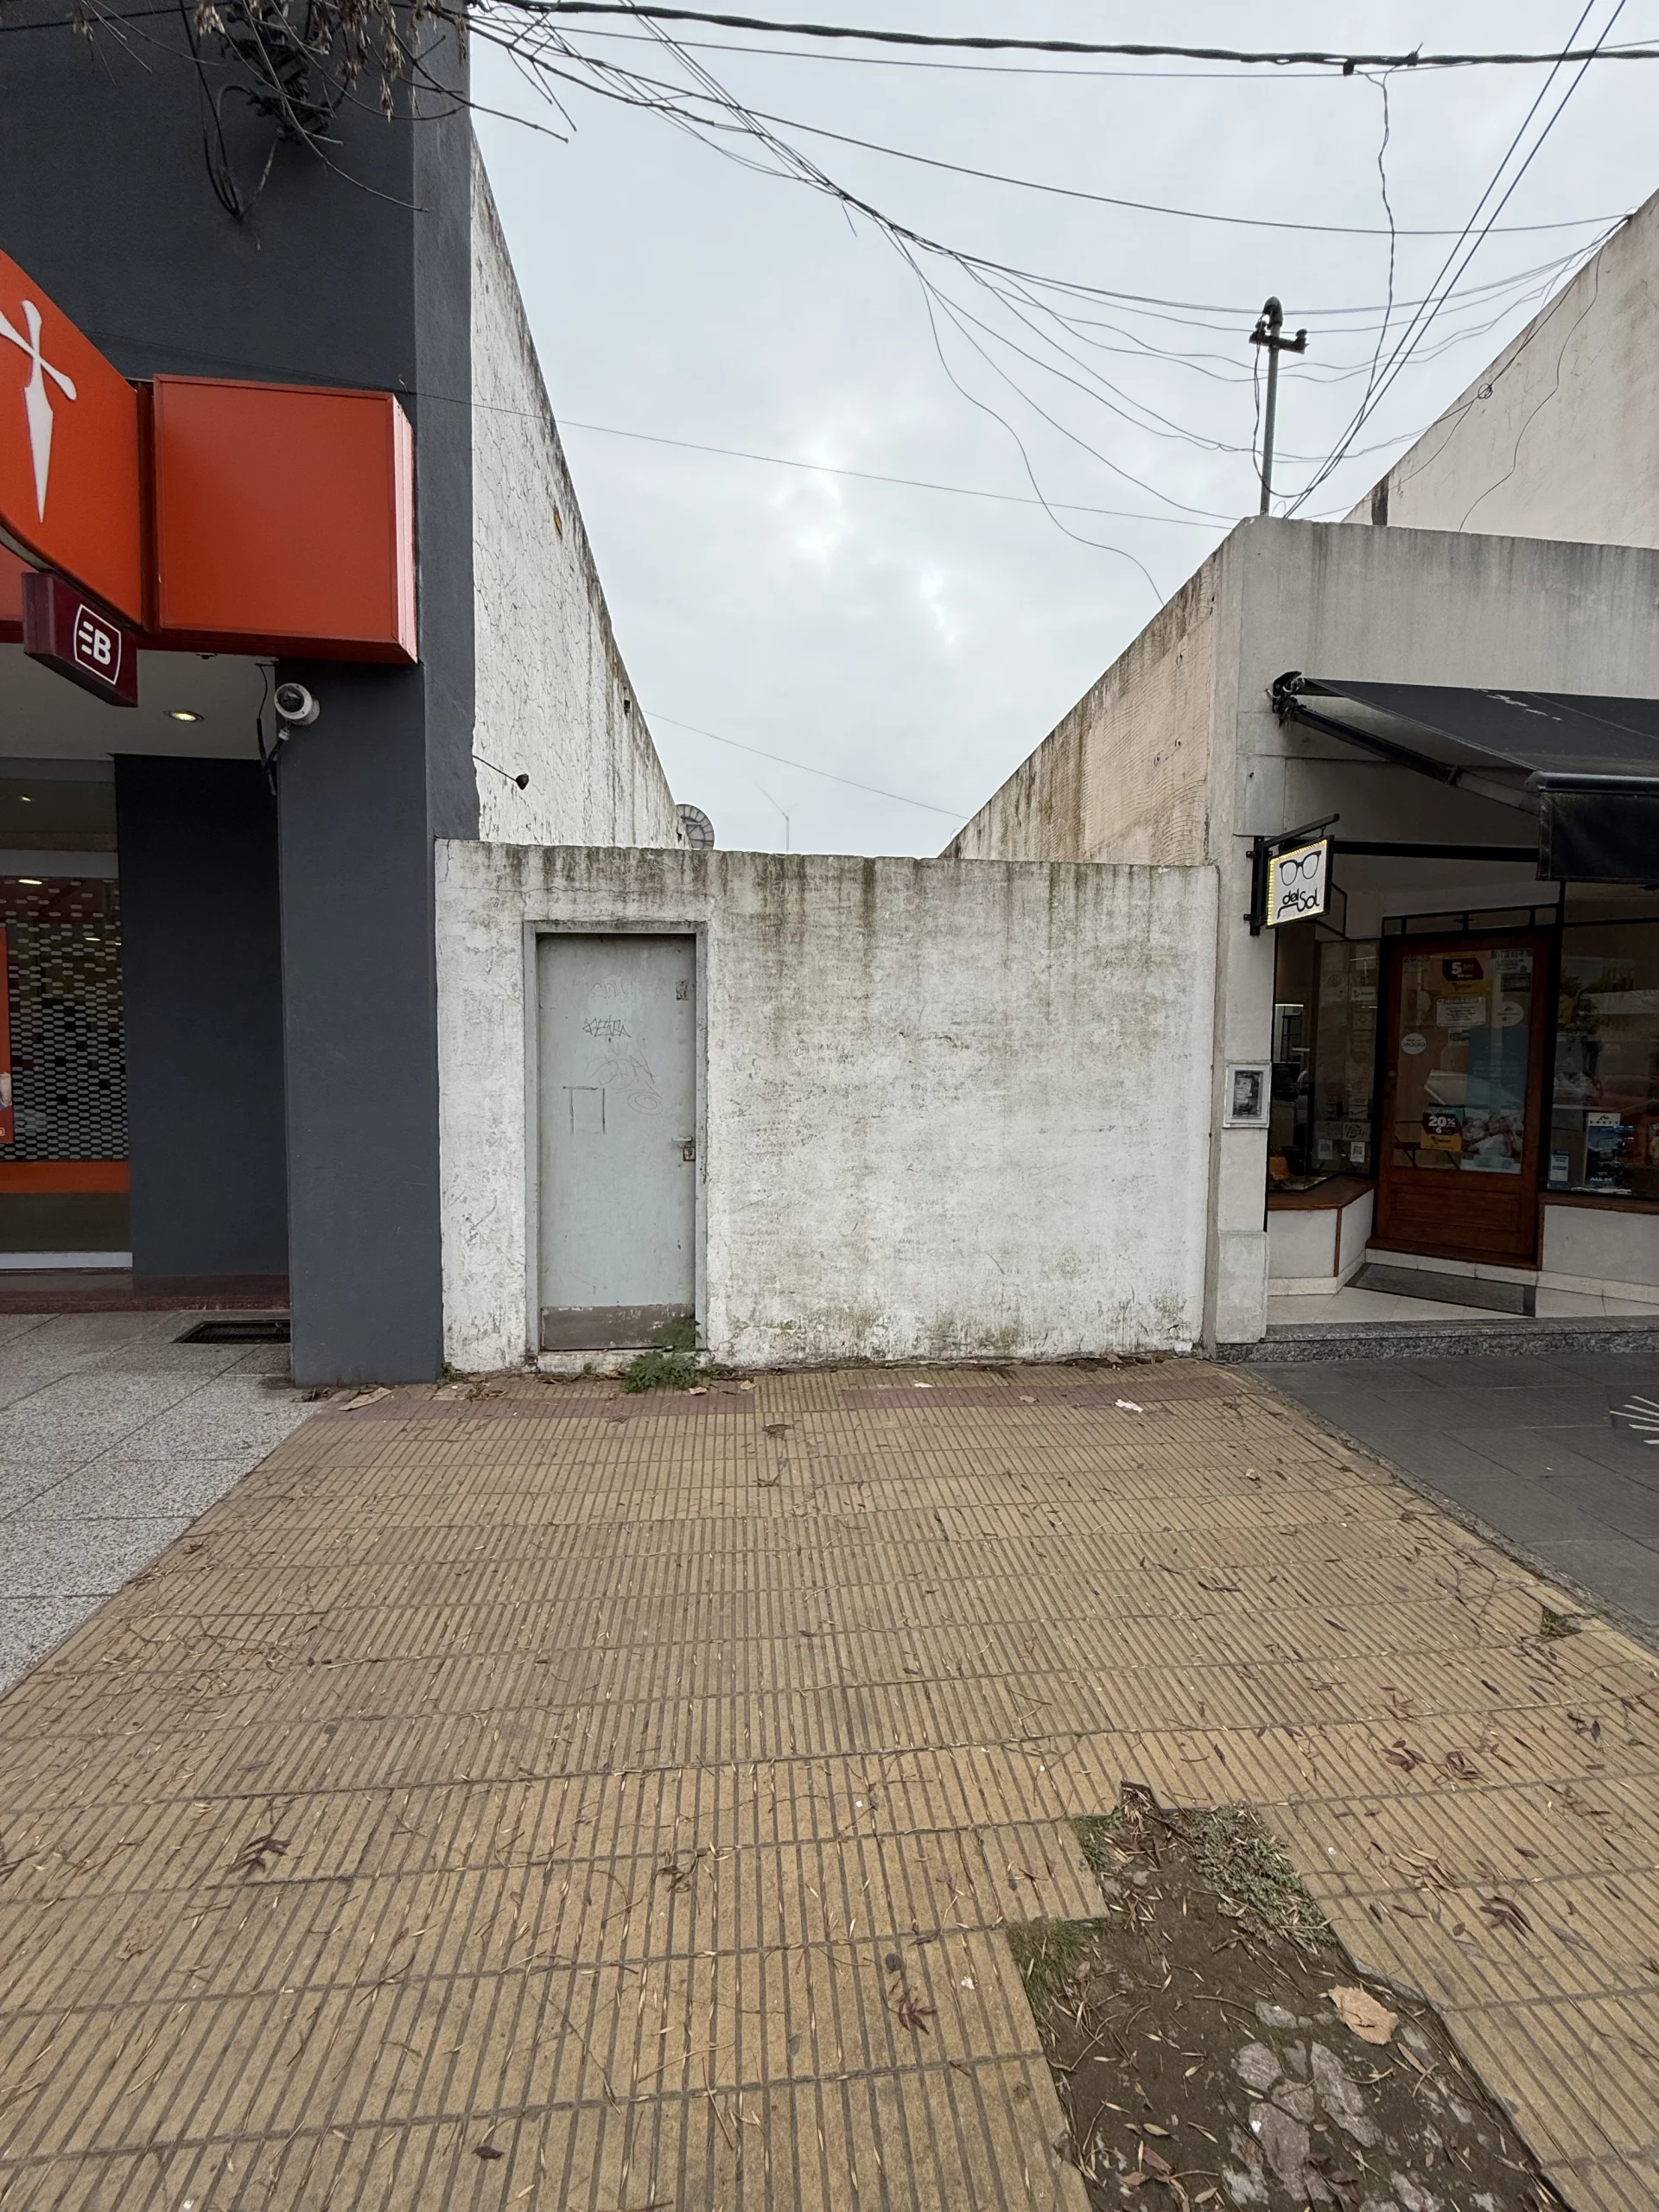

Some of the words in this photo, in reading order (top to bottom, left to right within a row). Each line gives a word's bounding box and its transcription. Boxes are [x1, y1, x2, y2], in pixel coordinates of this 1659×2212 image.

[1282, 888, 1300, 905] del
[1297, 887, 1320, 912] Sol
[1451, 962, 1462, 975] 5
[1428, 1116, 1456, 1127] 20%
